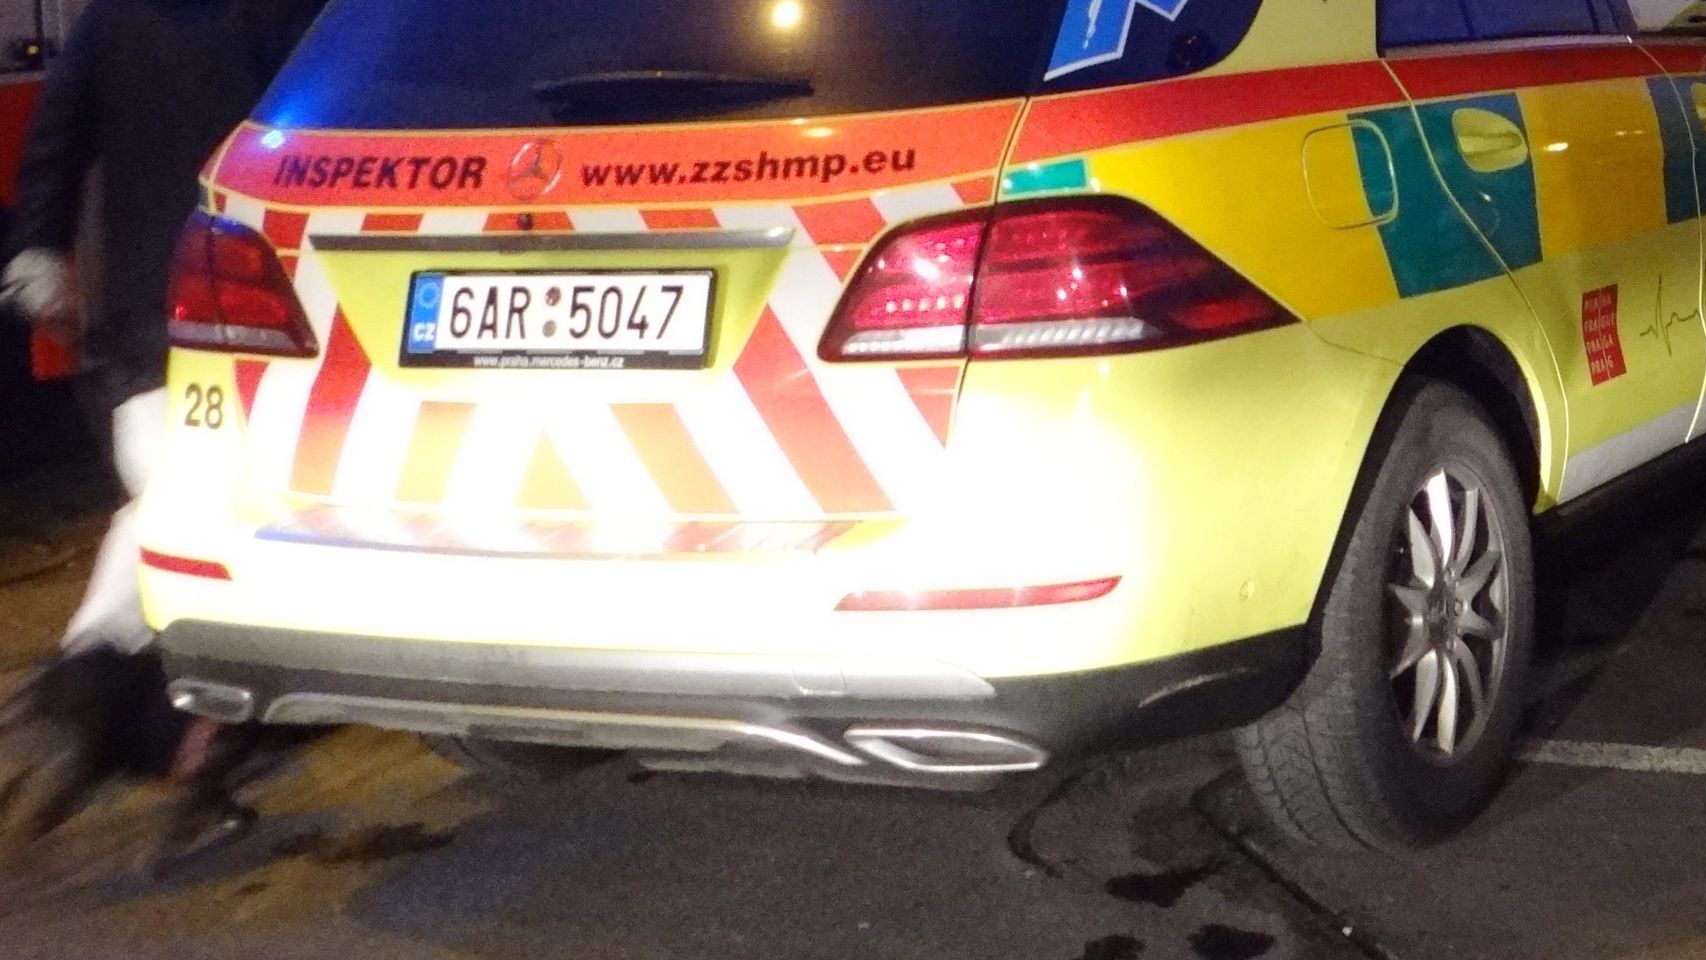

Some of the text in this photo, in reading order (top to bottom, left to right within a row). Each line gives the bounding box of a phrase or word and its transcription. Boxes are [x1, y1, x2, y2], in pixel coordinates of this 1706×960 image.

[273, 154, 487, 190] INSPEKTOR
[581, 148, 916, 186] www.zzshmp.eu
[414, 285, 684, 341] CZ 6AR 5047
[184, 383, 224, 430] 28
